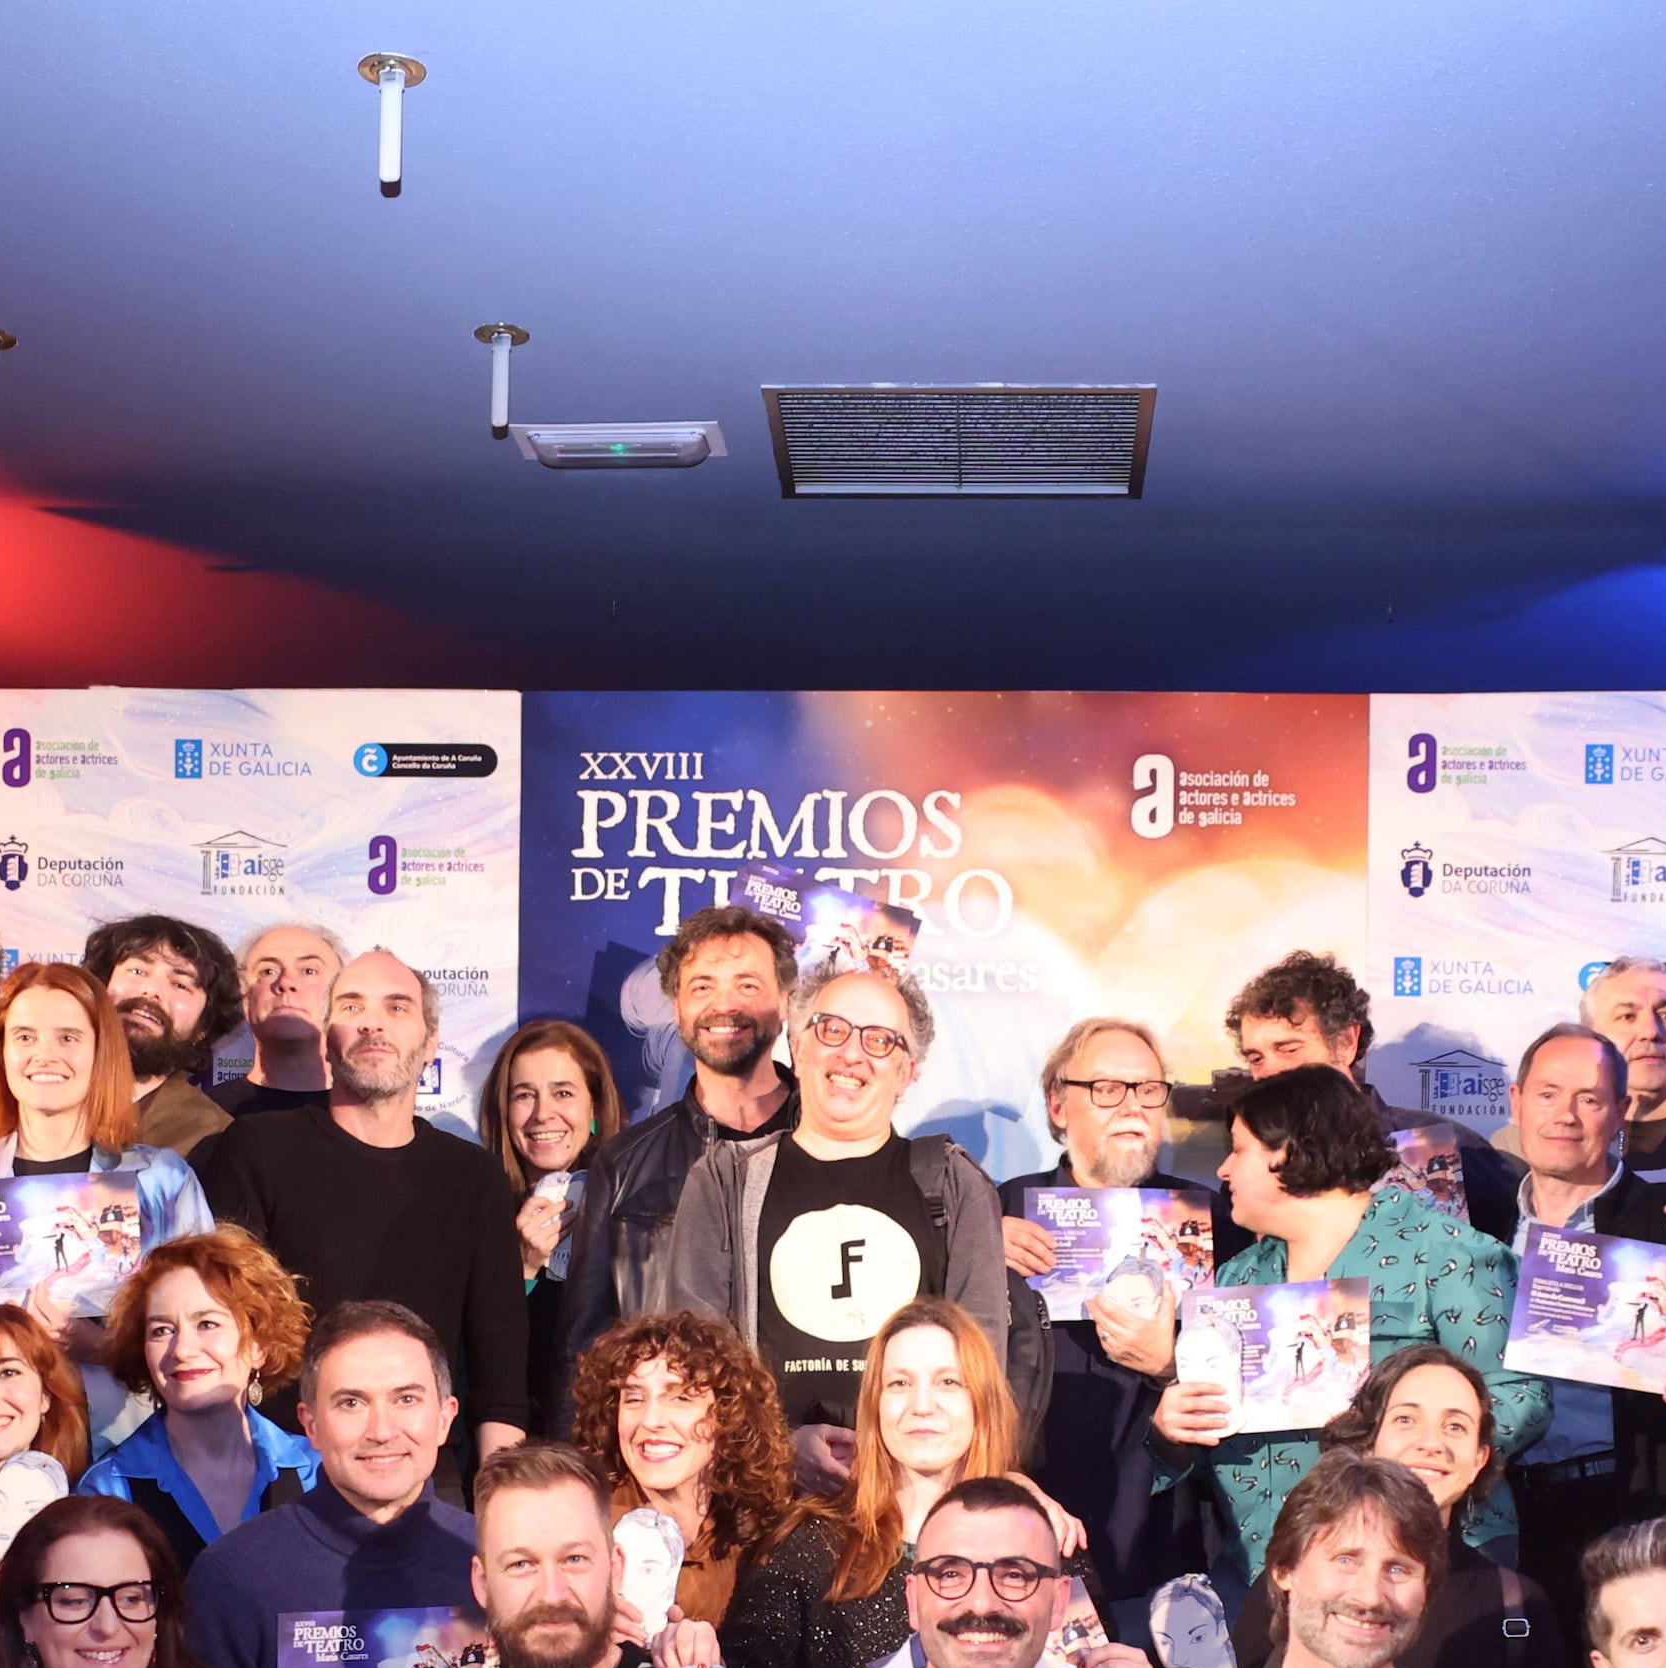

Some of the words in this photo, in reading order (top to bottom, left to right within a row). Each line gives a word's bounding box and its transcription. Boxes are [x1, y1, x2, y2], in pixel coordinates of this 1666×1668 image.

[36, 740, 85, 751] asociación
[88, 740, 100, 751] de
[210, 742, 273, 758] XUNTA
[1495, 745, 1507, 757] de
[36, 754, 70, 765] actores
[73, 757, 78, 765] e
[81, 754, 118, 765] actrices
[578, 751, 704, 780] XXVIII
[1441, 759, 1477, 770] actores
[1479, 761, 1485, 770] e
[1488, 759, 1526, 771] actrices
[36, 767, 46, 778] de
[50, 767, 80, 780] galicia
[209, 762, 232, 776] DE
[239, 761, 312, 776] GALICIA
[1621, 767, 1644, 781] DE
[1179, 770, 1250, 787] asociación
[1252, 770, 1269, 787] de
[1441, 773, 1452, 784] de
[1455, 773, 1487, 786] galicia
[1179, 790, 1228, 806] actores
[1231, 793, 1239, 806] e
[1242, 790, 1296, 806] actrices
[570, 788, 963, 860] PREMIOS
[1179, 807, 1194, 825] de
[1198, 807, 1243, 828] galicia
[401, 847, 451, 858] asociación
[455, 847, 466, 858] de
[38, 856, 124, 874] Deputación
[243, 853, 285, 882] aisge
[401, 861, 436, 872] actores
[438, 863, 444, 872] e
[447, 861, 484, 872] actrices
[1443, 862, 1531, 880] Deputación
[37, 874, 57, 887] DA
[62, 871, 124, 887] CORUÑA
[401, 874, 412, 886] de
[416, 874, 446, 888] galicia
[570, 867, 630, 901] DE
[1442, 880, 1462, 894] DA
[1467, 878, 1531, 894] CORUÑA
[214, 884, 285, 896] FUNDACIÓN
[424, 967, 489, 980] putación
[1430, 960, 1494, 976] XUNTA
[437, 981, 489, 996] ORUÑA
[1429, 980, 1451, 994] DE
[1458, 979, 1534, 995] GALICIA
[437, 1041, 470, 1063] Cultura
[1463, 1073, 1505, 1102] aisge
[425, 1104, 437, 1112] de
[1432, 1103, 1505, 1116] FUNDACIÓN
[785, 1357, 832, 1373] FACTORÍA
[836, 1359, 849, 1372] DE
[293, 1625, 357, 1640] PREMIOS
[304, 1638, 365, 1654] TEATRO
